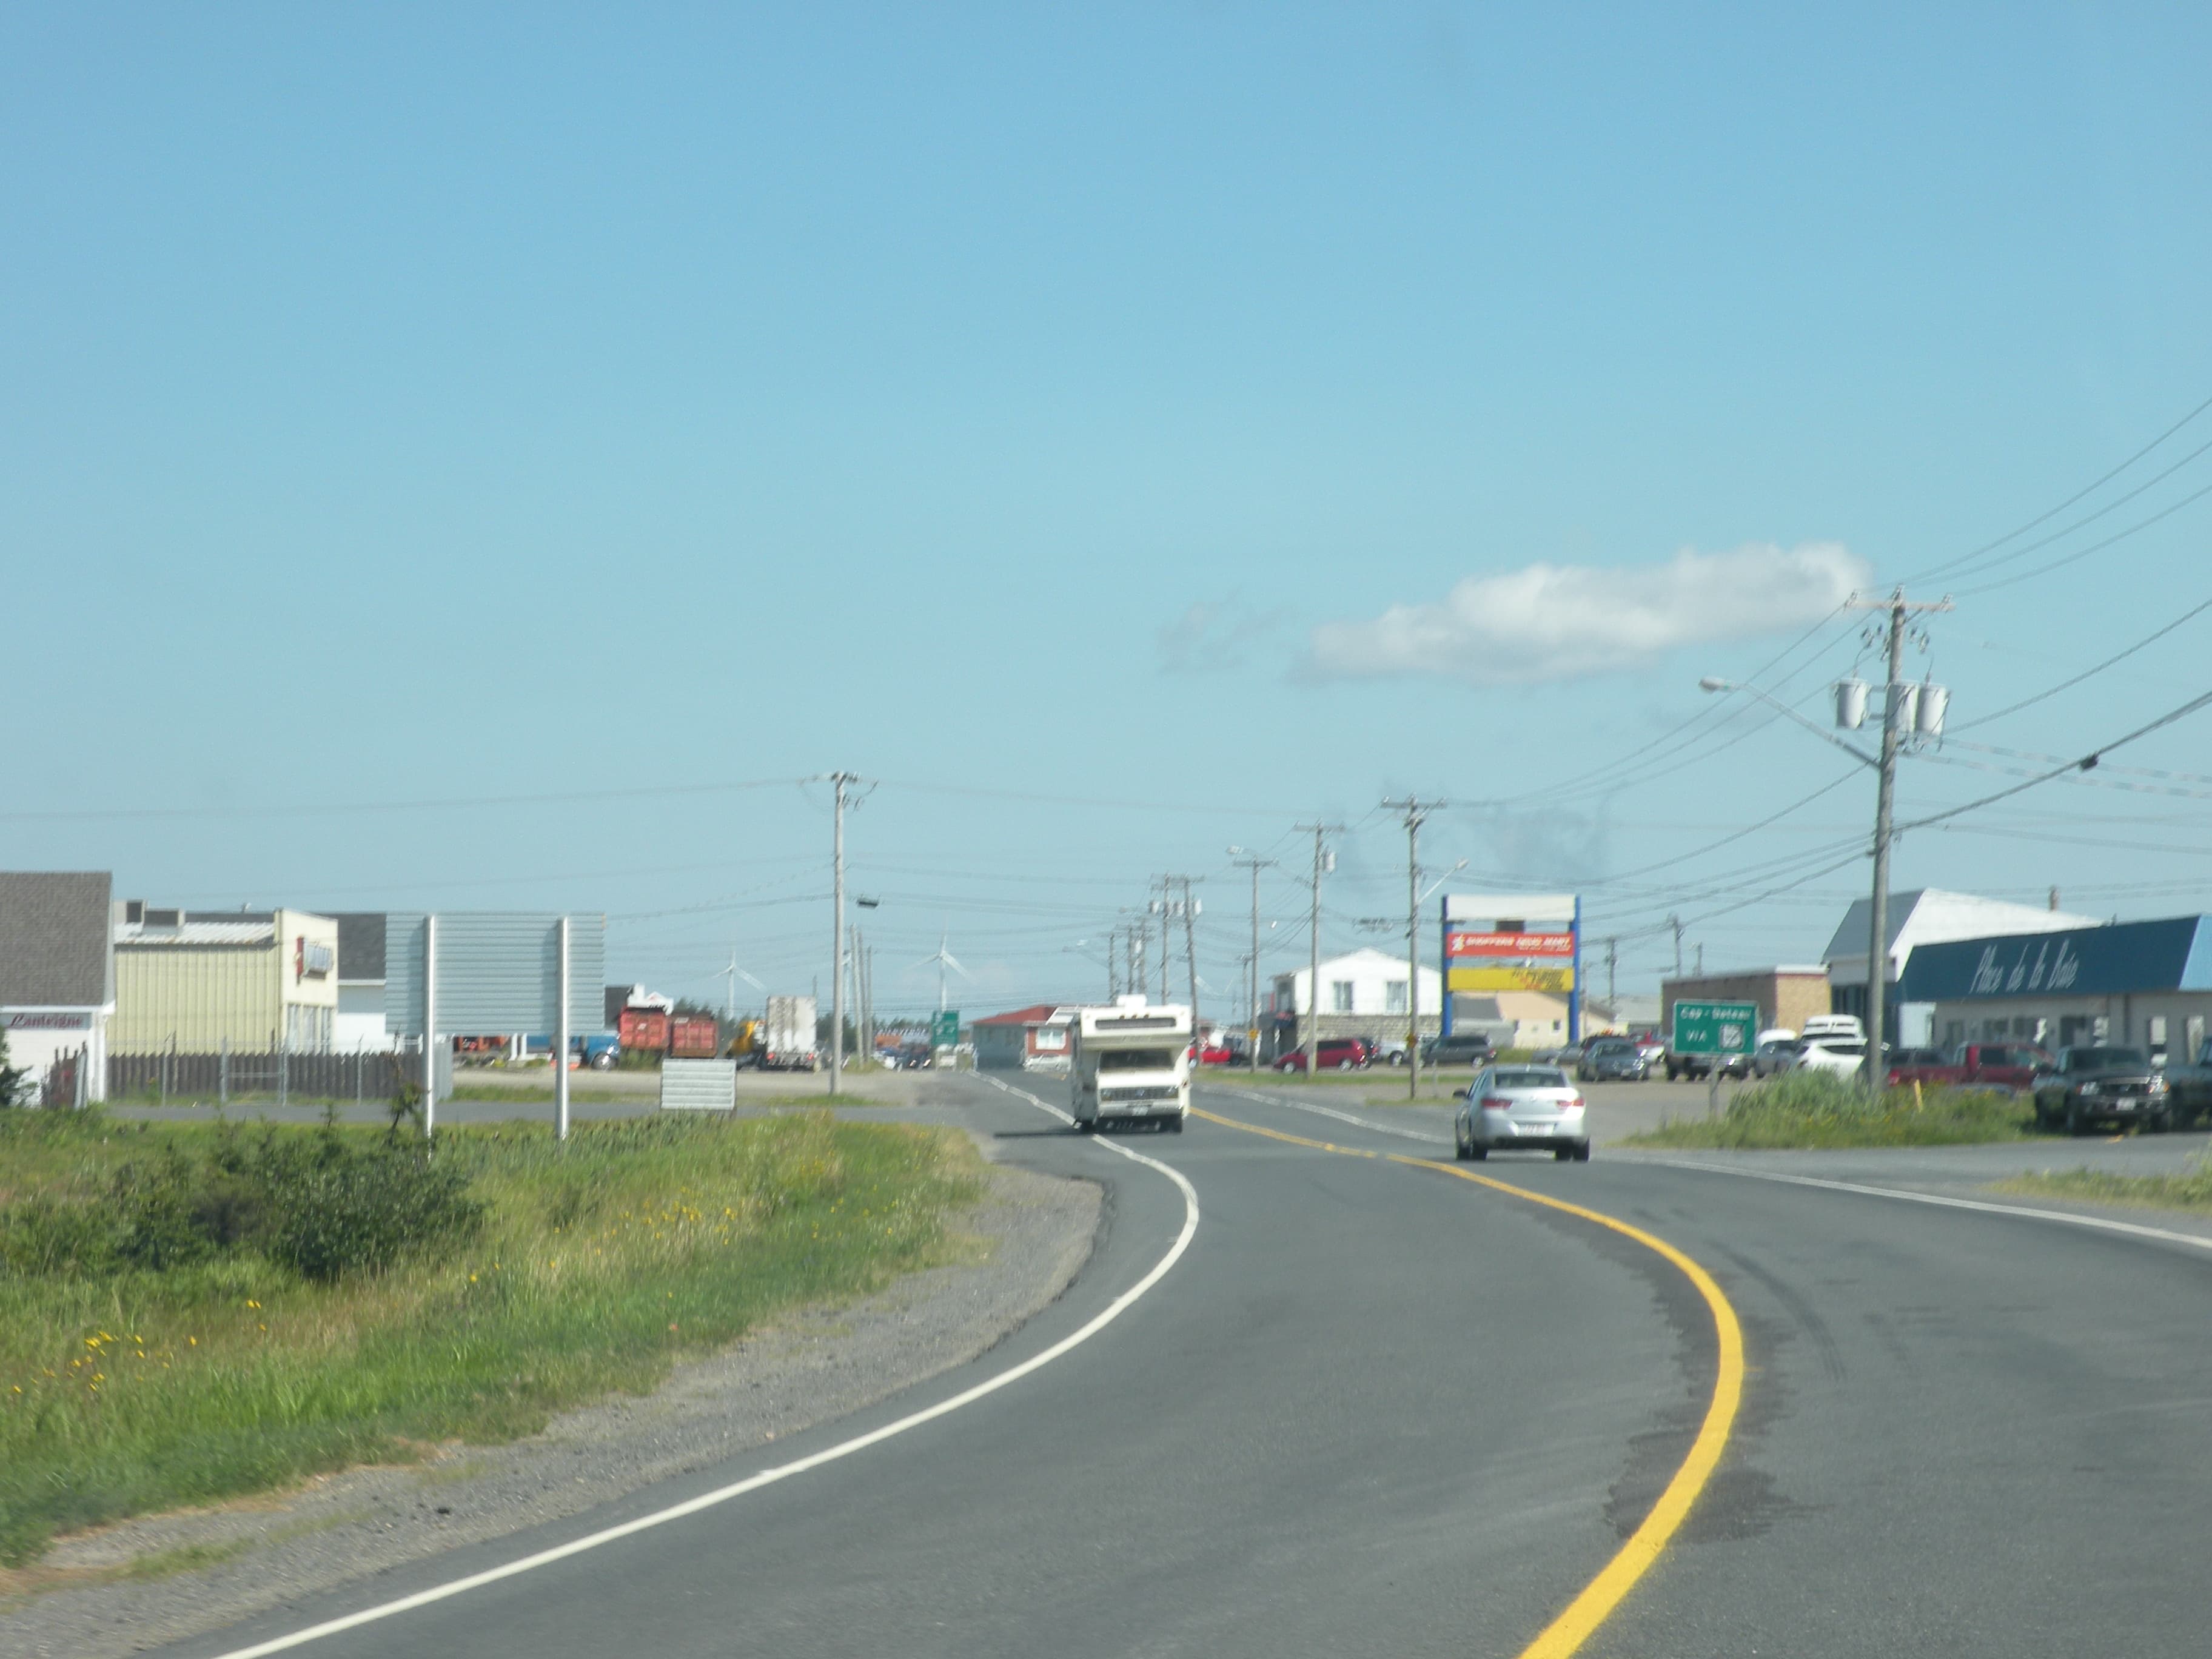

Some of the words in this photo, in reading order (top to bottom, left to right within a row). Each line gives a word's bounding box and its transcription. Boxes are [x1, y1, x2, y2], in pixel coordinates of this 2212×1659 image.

[1969, 944, 2003, 994] Place
[2006, 943, 2029, 993] de
[2027, 940, 2049, 991] la
[1686, 1029, 1708, 1042] VIA
